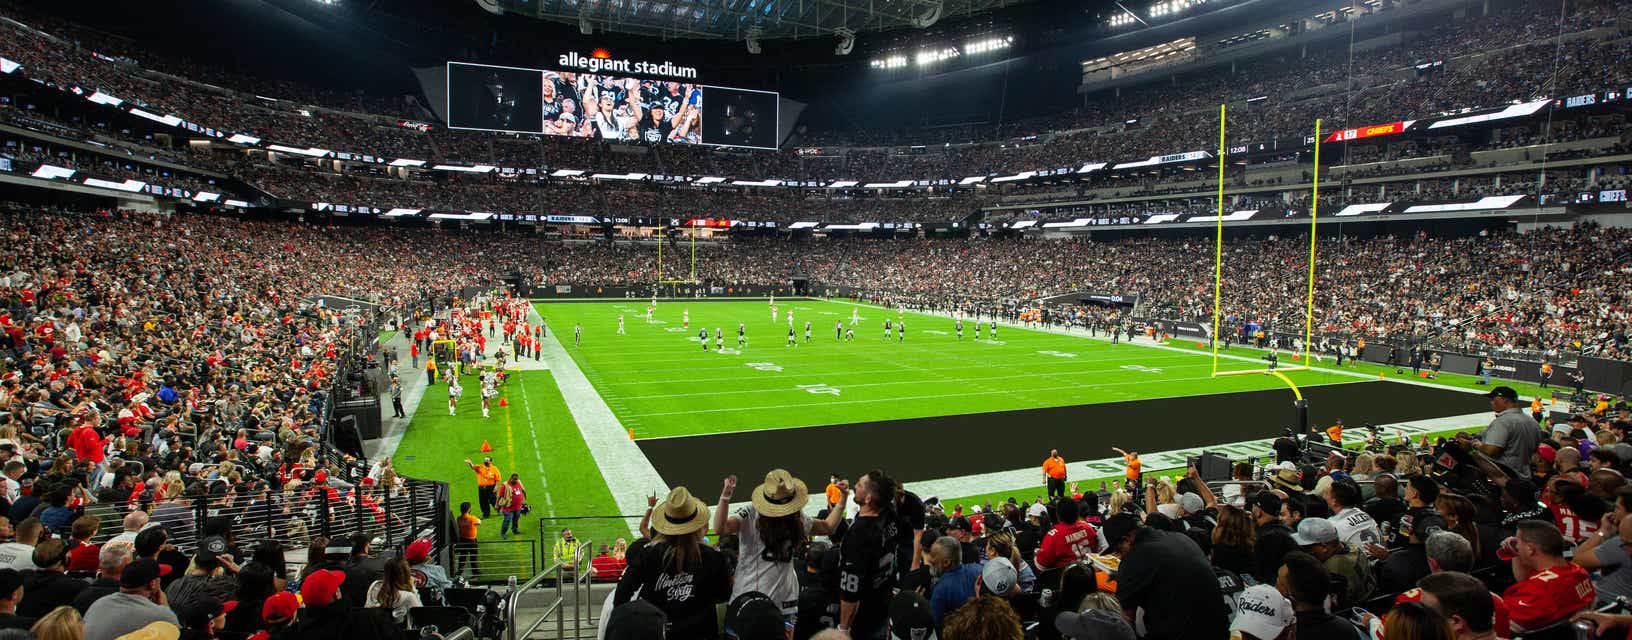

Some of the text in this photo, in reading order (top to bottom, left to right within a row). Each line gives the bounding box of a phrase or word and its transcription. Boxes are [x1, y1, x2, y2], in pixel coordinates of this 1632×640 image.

[559, 52, 697, 79] allegiant stadium
[1566, 94, 1596, 108] RAIDERS
[1366, 126, 1395, 136] CHIEFS
[1161, 154, 1186, 162] RAIDERS
[654, 572, 694, 592] Nineteen
[840, 570, 859, 593] 28
[666, 584, 695, 602] Sixty
[1238, 597, 1276, 617] Raiders
